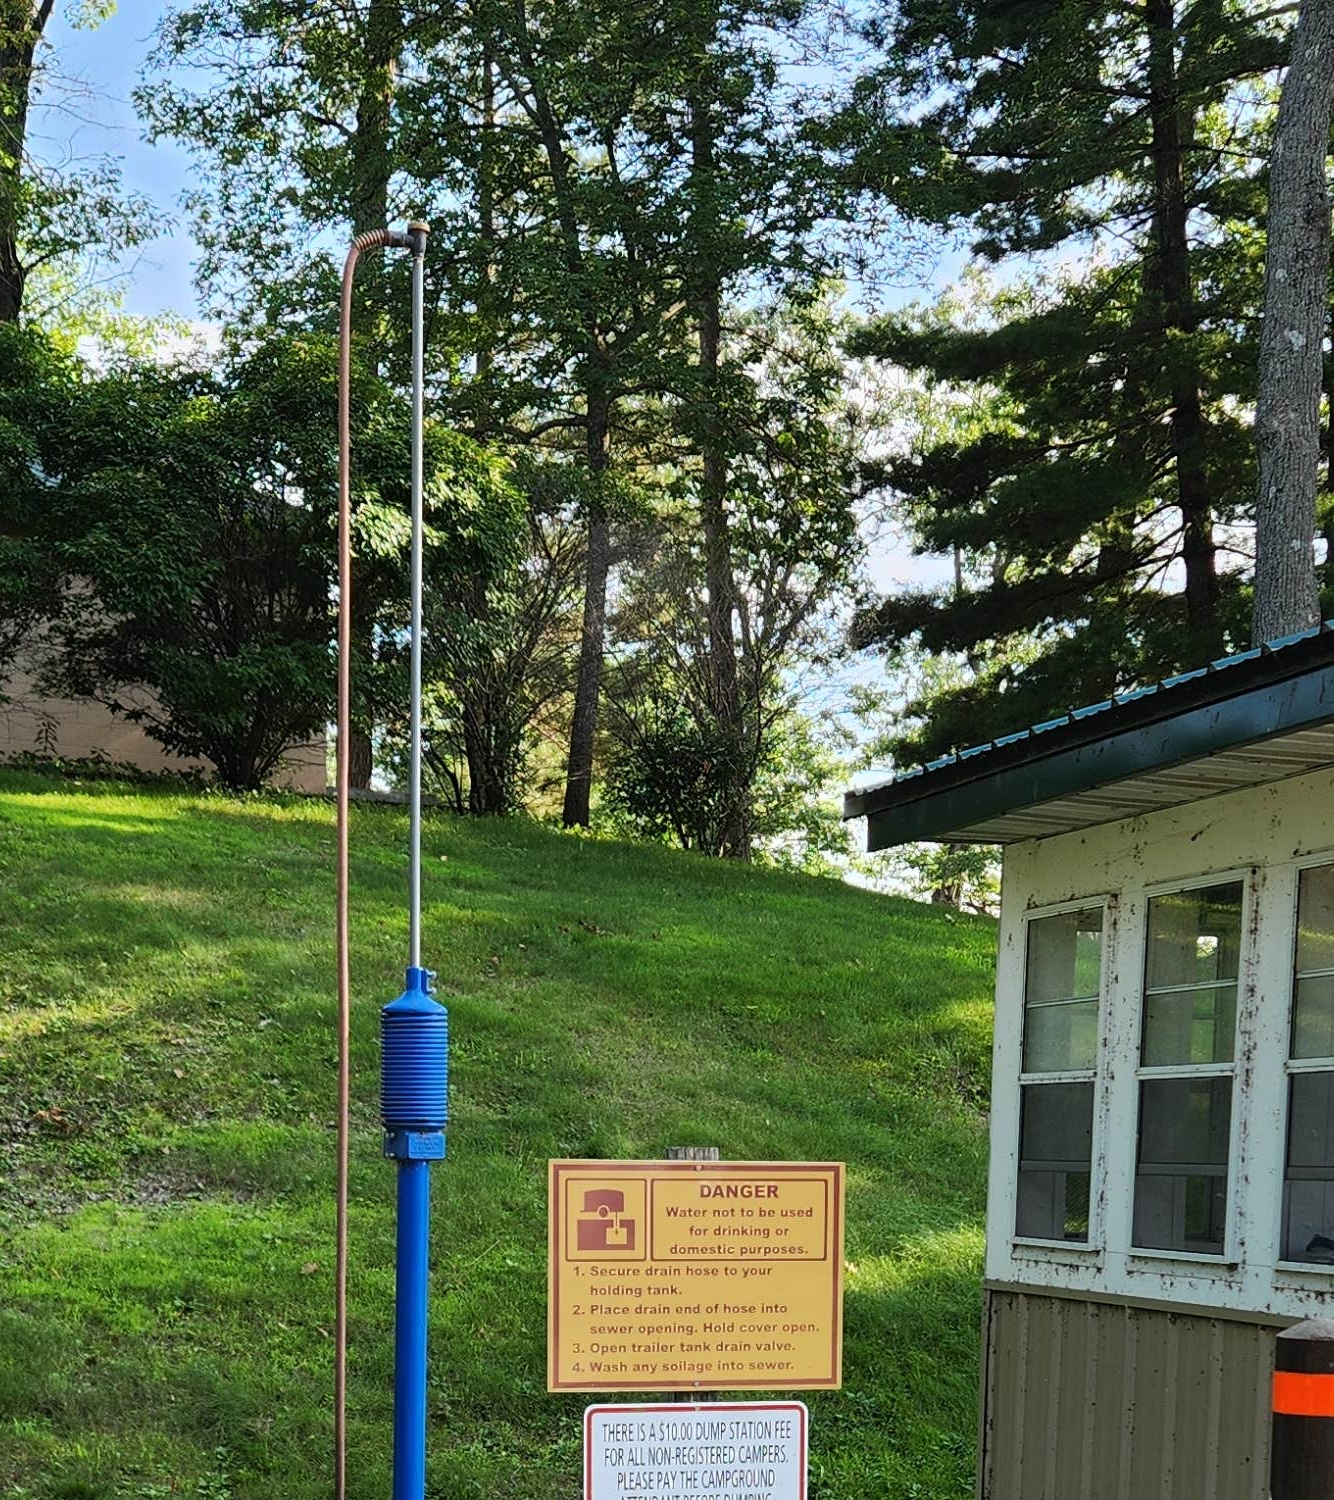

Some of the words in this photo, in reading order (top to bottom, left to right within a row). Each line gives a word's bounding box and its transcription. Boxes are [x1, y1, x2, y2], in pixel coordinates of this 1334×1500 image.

[699, 1184, 779, 1199] DANGER
[665, 1206, 708, 1218] Water
[713, 1208, 735, 1218] not
[740, 1207, 754, 1218] to
[758, 1206, 775, 1218] be
[780, 1206, 813, 1218] used
[689, 1225, 708, 1236] for
[713, 1225, 770, 1239] drinking
[775, 1227, 790, 1236] or
[669, 1244, 735, 1255] domestic
[740, 1245, 809, 1258] purposes.
[572, 1266, 586, 1277] 1.
[590, 1265, 640, 1277] Secure
[645, 1265, 681, 1277] drain
[686, 1265, 719, 1276] hose
[724, 1266, 738, 1276] to
[742, 1267, 773, 1279] your
[589, 1284, 642, 1298] holding
[647, 1284, 683, 1296] tank.
[572, 1304, 586, 1315] 2.
[590, 1304, 629, 1315] Place
[634, 1303, 671, 1315] drain
[675, 1303, 700, 1315] end
[705, 1303, 720, 1314] of
[723, 1303, 757, 1314] hose
[761, 1302, 788, 1314] into
[589, 1324, 634, 1334] sewer
[638, 1323, 698, 1336] opening.
[703, 1322, 735, 1333] Hold
[739, 1323, 777, 1333] cover
[782, 1323, 820, 1335] open.
[572, 1343, 586, 1354] 3.
[589, 1343, 627, 1355] Open
[631, 1341, 675, 1353] trailer
[680, 1341, 710, 1353] tank
[716, 1340, 751, 1352] drain
[756, 1340, 796, 1352] valve.
[572, 1363, 586, 1373] 4.
[589, 1362, 628, 1373] Wash
[632, 1364, 657, 1375] any
[662, 1361, 713, 1375] soilage
[717, 1361, 745, 1372] into
[748, 1362, 795, 1371] sewer.
[602, 1423, 634, 1442] THERE
[637, 1423, 646, 1442] IS
[648, 1423, 657, 1442] A
[659, 1421, 693, 1442] $10.00
[695, 1421, 727, 1441] DUMP
[729, 1420, 772, 1441] STATION
[774, 1420, 792, 1440] FEE
[604, 1448, 624, 1467] FOR
[627, 1447, 646, 1466] ALL
[648, 1445, 736, 1467] NON-REGISTERED
[738, 1444, 789, 1464] CAMPERS.
[617, 1471, 654, 1491] PLEASE
[656, 1470, 678, 1490] PAY
[680, 1470, 699, 1489] THE
[701, 1469, 776, 1489] CAMPGROUND
